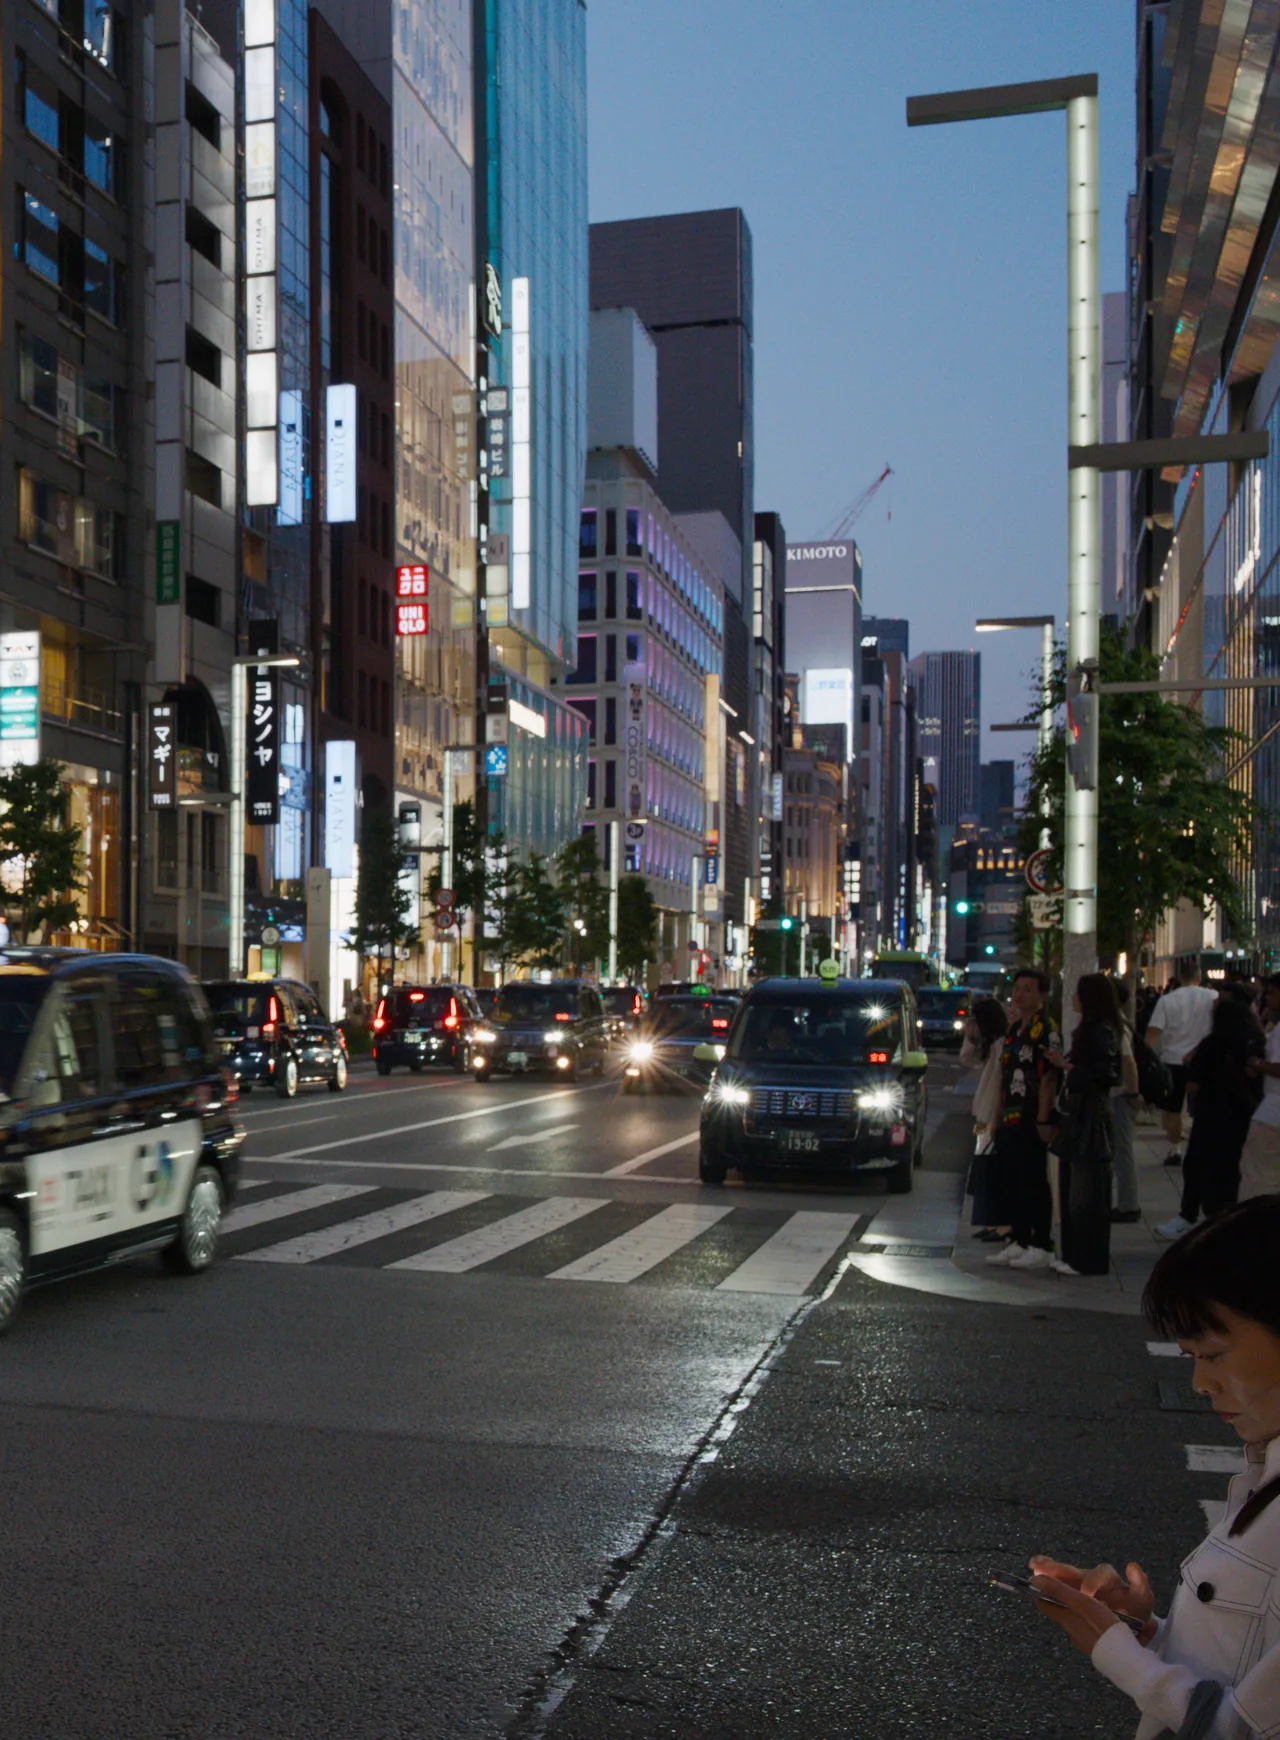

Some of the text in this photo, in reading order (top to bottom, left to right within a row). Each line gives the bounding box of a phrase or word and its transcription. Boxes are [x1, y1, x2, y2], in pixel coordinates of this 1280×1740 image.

[333, 427, 346, 488] DIANA
[398, 606, 423, 619] UNI
[398, 619, 425, 634] QLO
[253, 681, 273, 766] ヨシノヤ
[153, 726, 171, 782] マギー
[332, 784, 345, 844] DIANA
